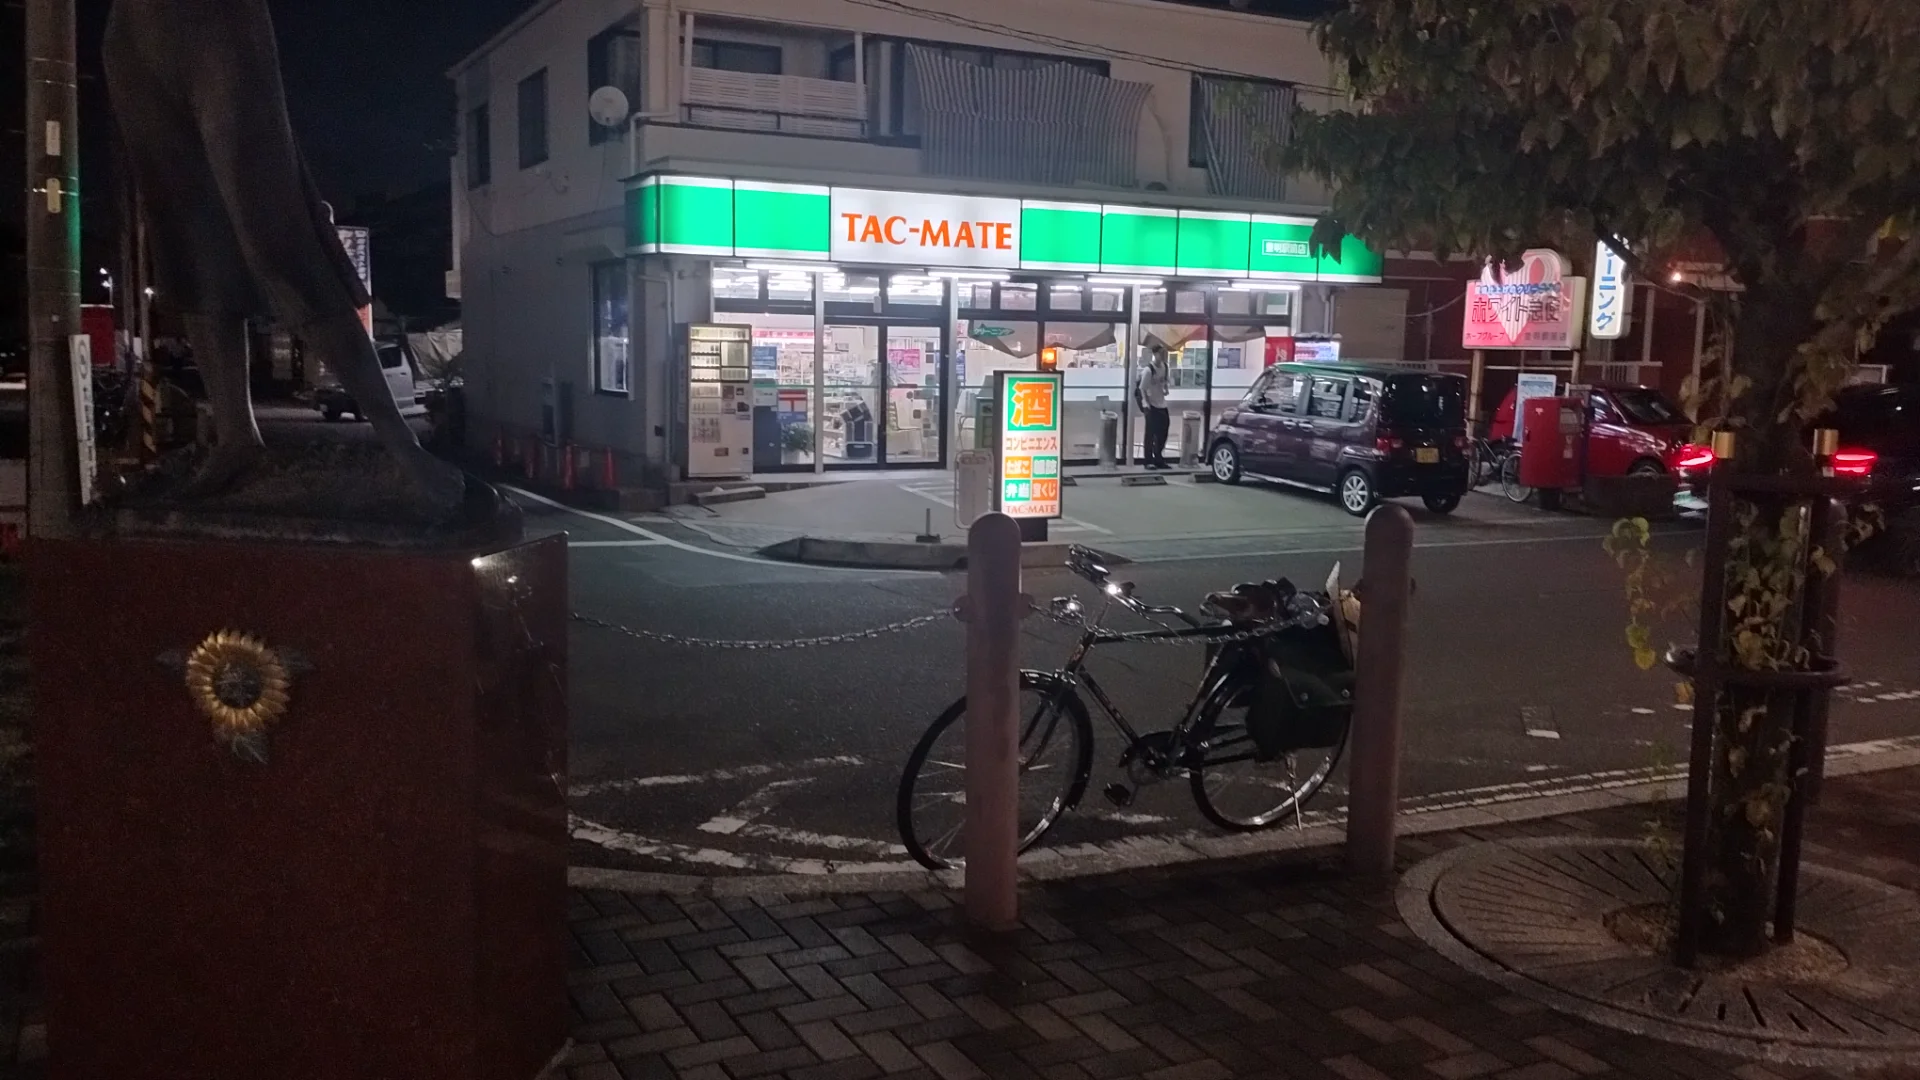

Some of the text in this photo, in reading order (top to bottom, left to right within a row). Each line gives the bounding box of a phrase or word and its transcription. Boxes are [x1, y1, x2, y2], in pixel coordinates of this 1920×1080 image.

[842, 213, 1012, 249] TAC-MATE
[1471, 296, 1561, 322] ホワイト急便
[1012, 380, 1054, 427] 酒
[1006, 436, 1058, 450] コンビニエンス
[1006, 482, 1030, 499] 弁当
[1006, 504, 1057, 514] TAC-MATE
